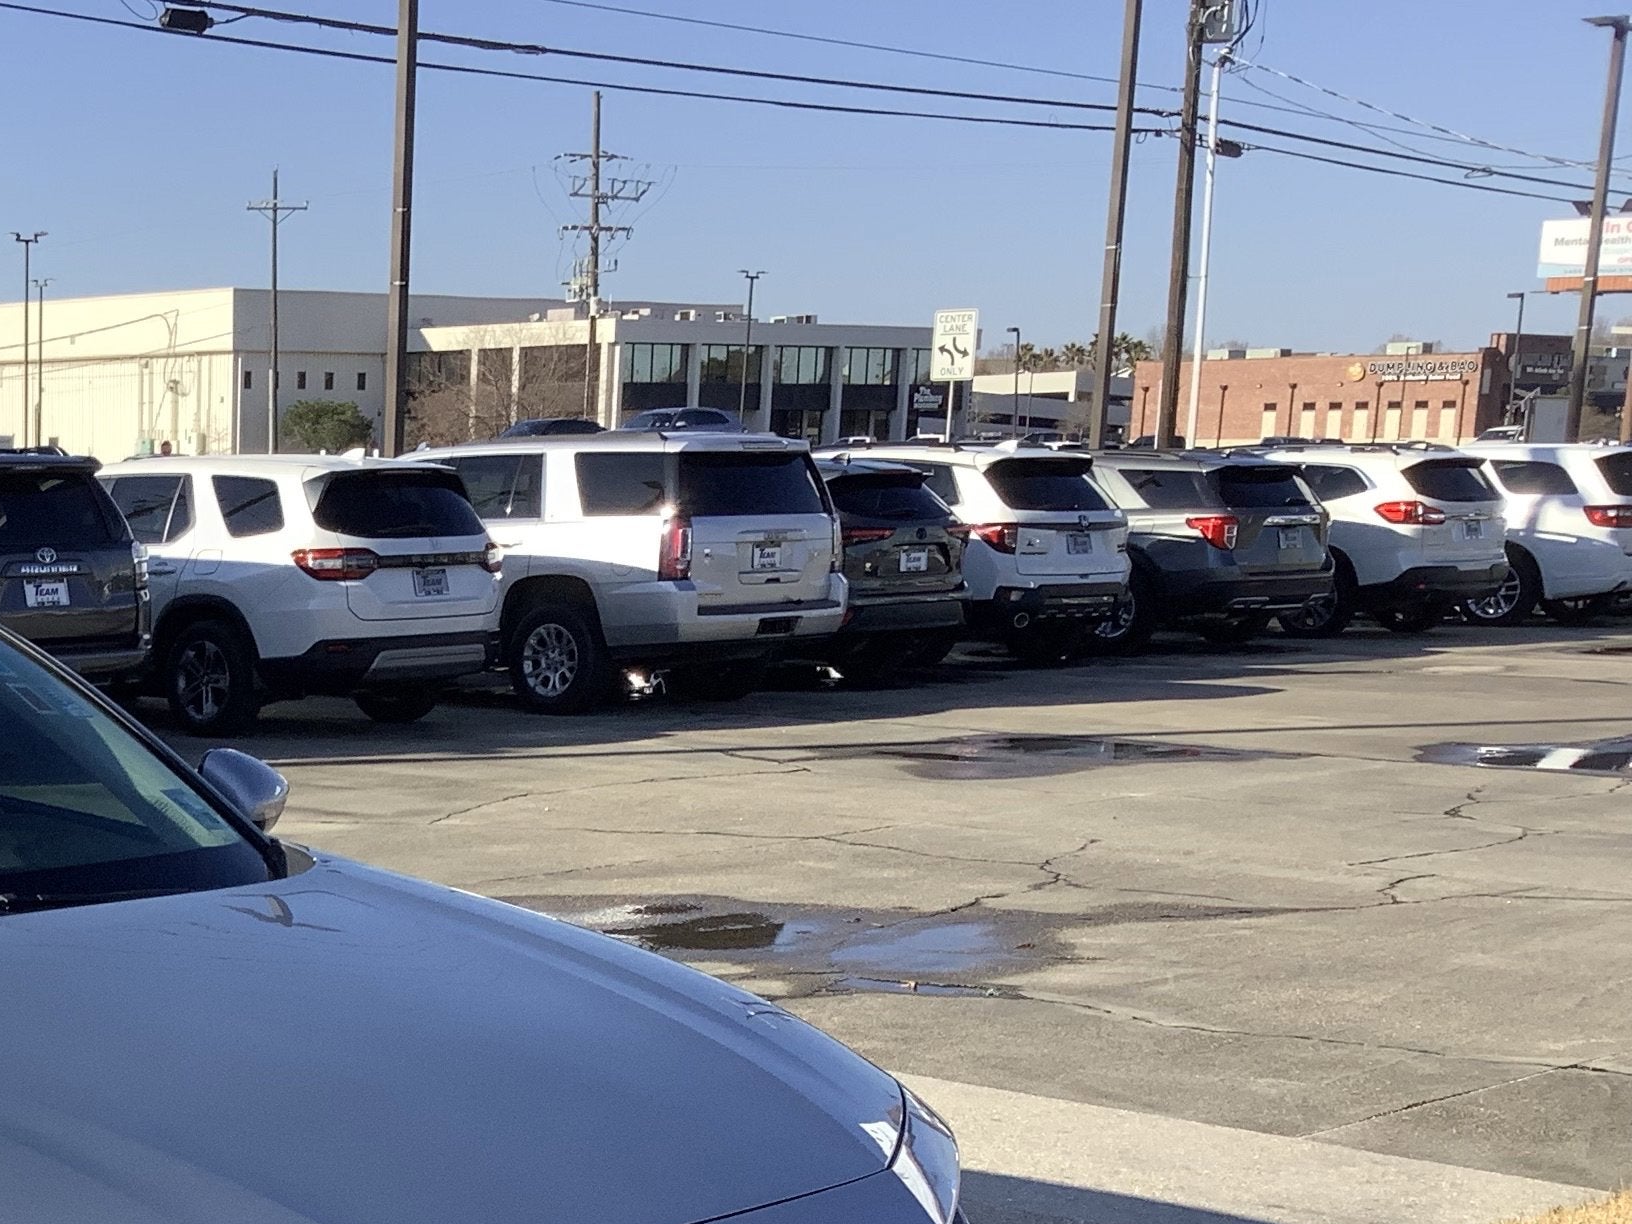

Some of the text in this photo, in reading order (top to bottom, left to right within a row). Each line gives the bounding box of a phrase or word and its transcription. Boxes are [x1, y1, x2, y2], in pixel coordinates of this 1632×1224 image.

[1554, 238, 1590, 247] Menta
[939, 314, 973, 323] CENTER
[943, 324, 968, 332] LANE
[1450, 360, 1478, 371] BAO
[940, 367, 964, 376] ONLY
[33, 584, 59, 597] TEAM
